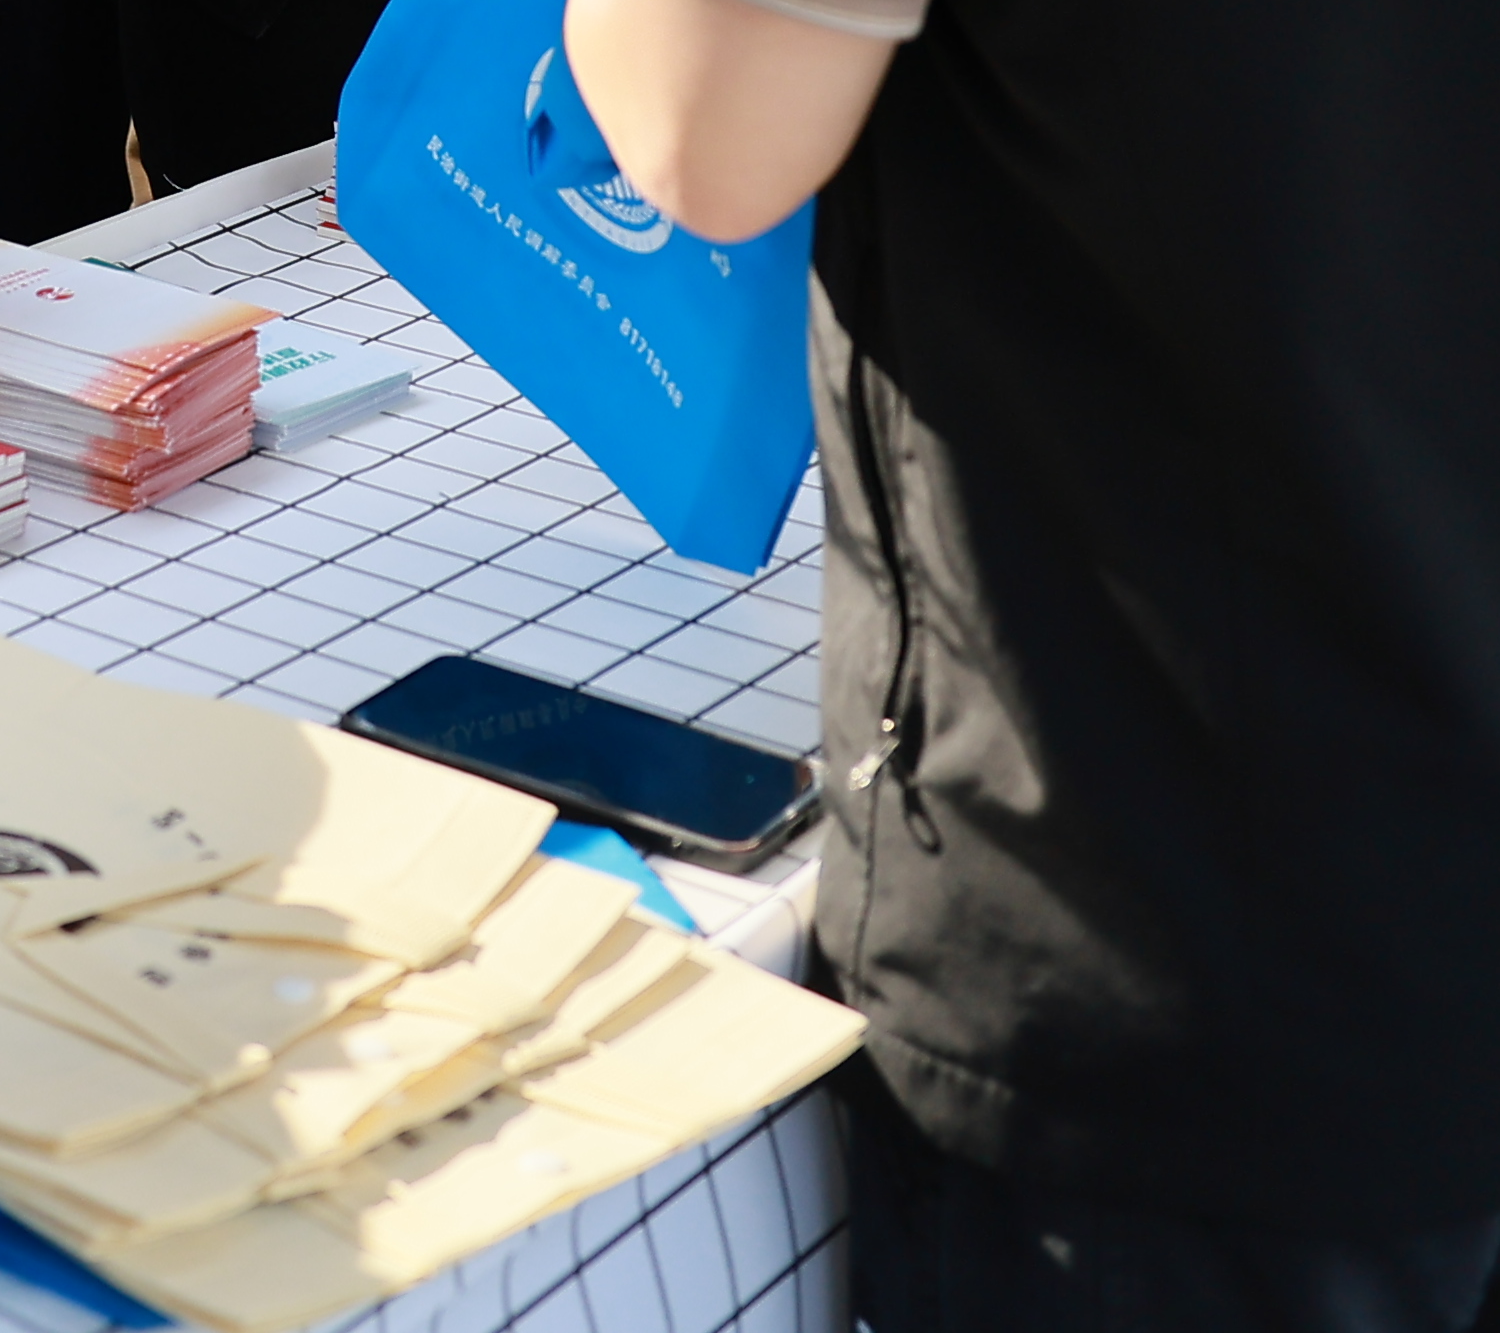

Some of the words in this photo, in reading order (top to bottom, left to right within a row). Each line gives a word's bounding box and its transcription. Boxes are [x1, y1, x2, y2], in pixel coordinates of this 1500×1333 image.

[426, 134, 613, 313] 民治街道人民调解委员会
